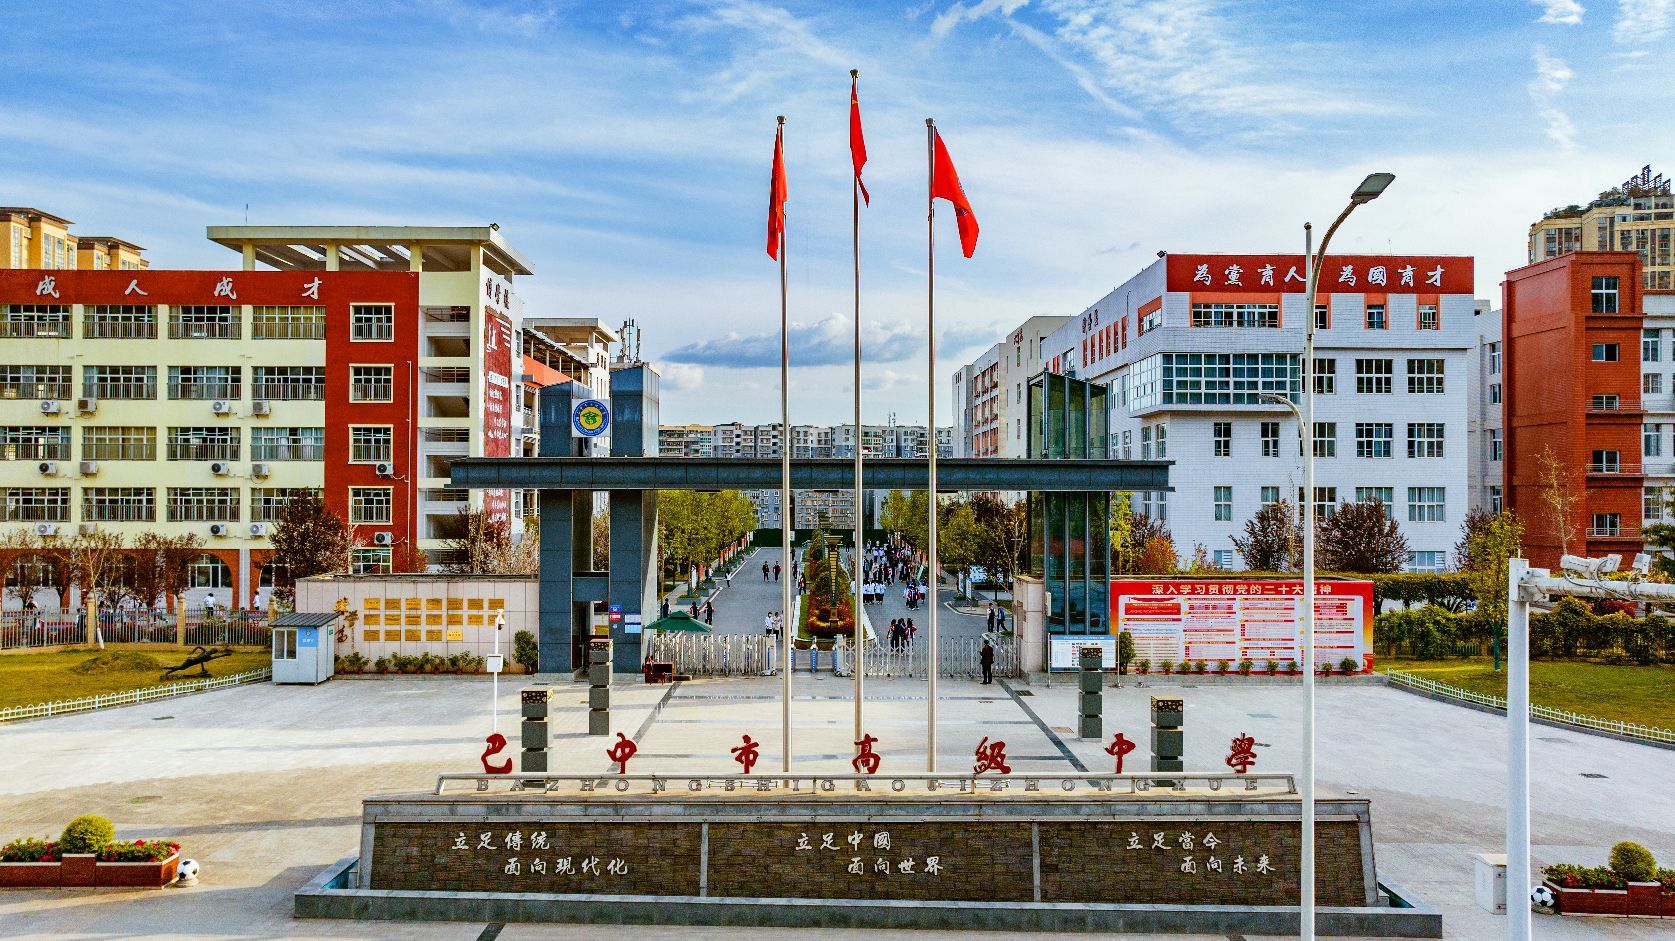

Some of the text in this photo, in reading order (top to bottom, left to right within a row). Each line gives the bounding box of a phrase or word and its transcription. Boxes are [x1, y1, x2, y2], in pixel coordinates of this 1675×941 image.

[1193, 264, 1446, 286] 為黨育人 為國育才
[35, 275, 323, 300] 成人成才
[481, 732, 1257, 775] 巴中市高級中學
[795, 830, 891, 851] 立足中國
[1126, 830, 1222, 850] 立足當今
[847, 856, 944, 876] 面向世界
